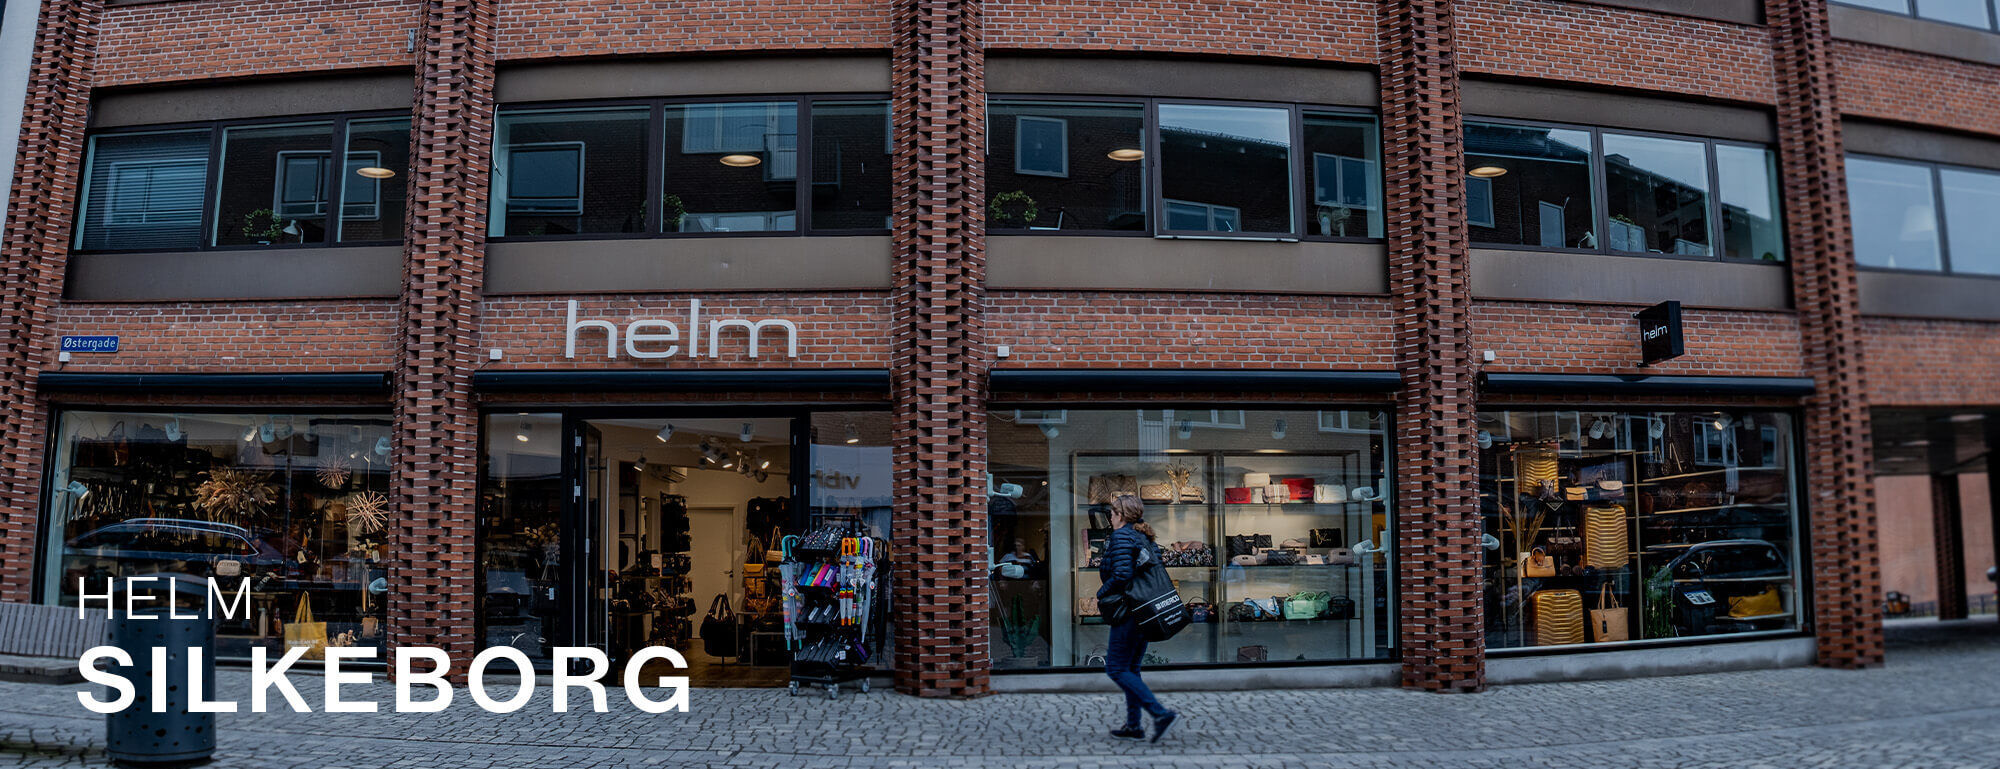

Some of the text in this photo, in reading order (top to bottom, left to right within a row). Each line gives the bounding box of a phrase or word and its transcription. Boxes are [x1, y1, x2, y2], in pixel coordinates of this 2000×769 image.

[565, 298, 797, 359] helm
[1643, 324, 1668, 341] helm
[63, 337, 116, 351] Østergade
